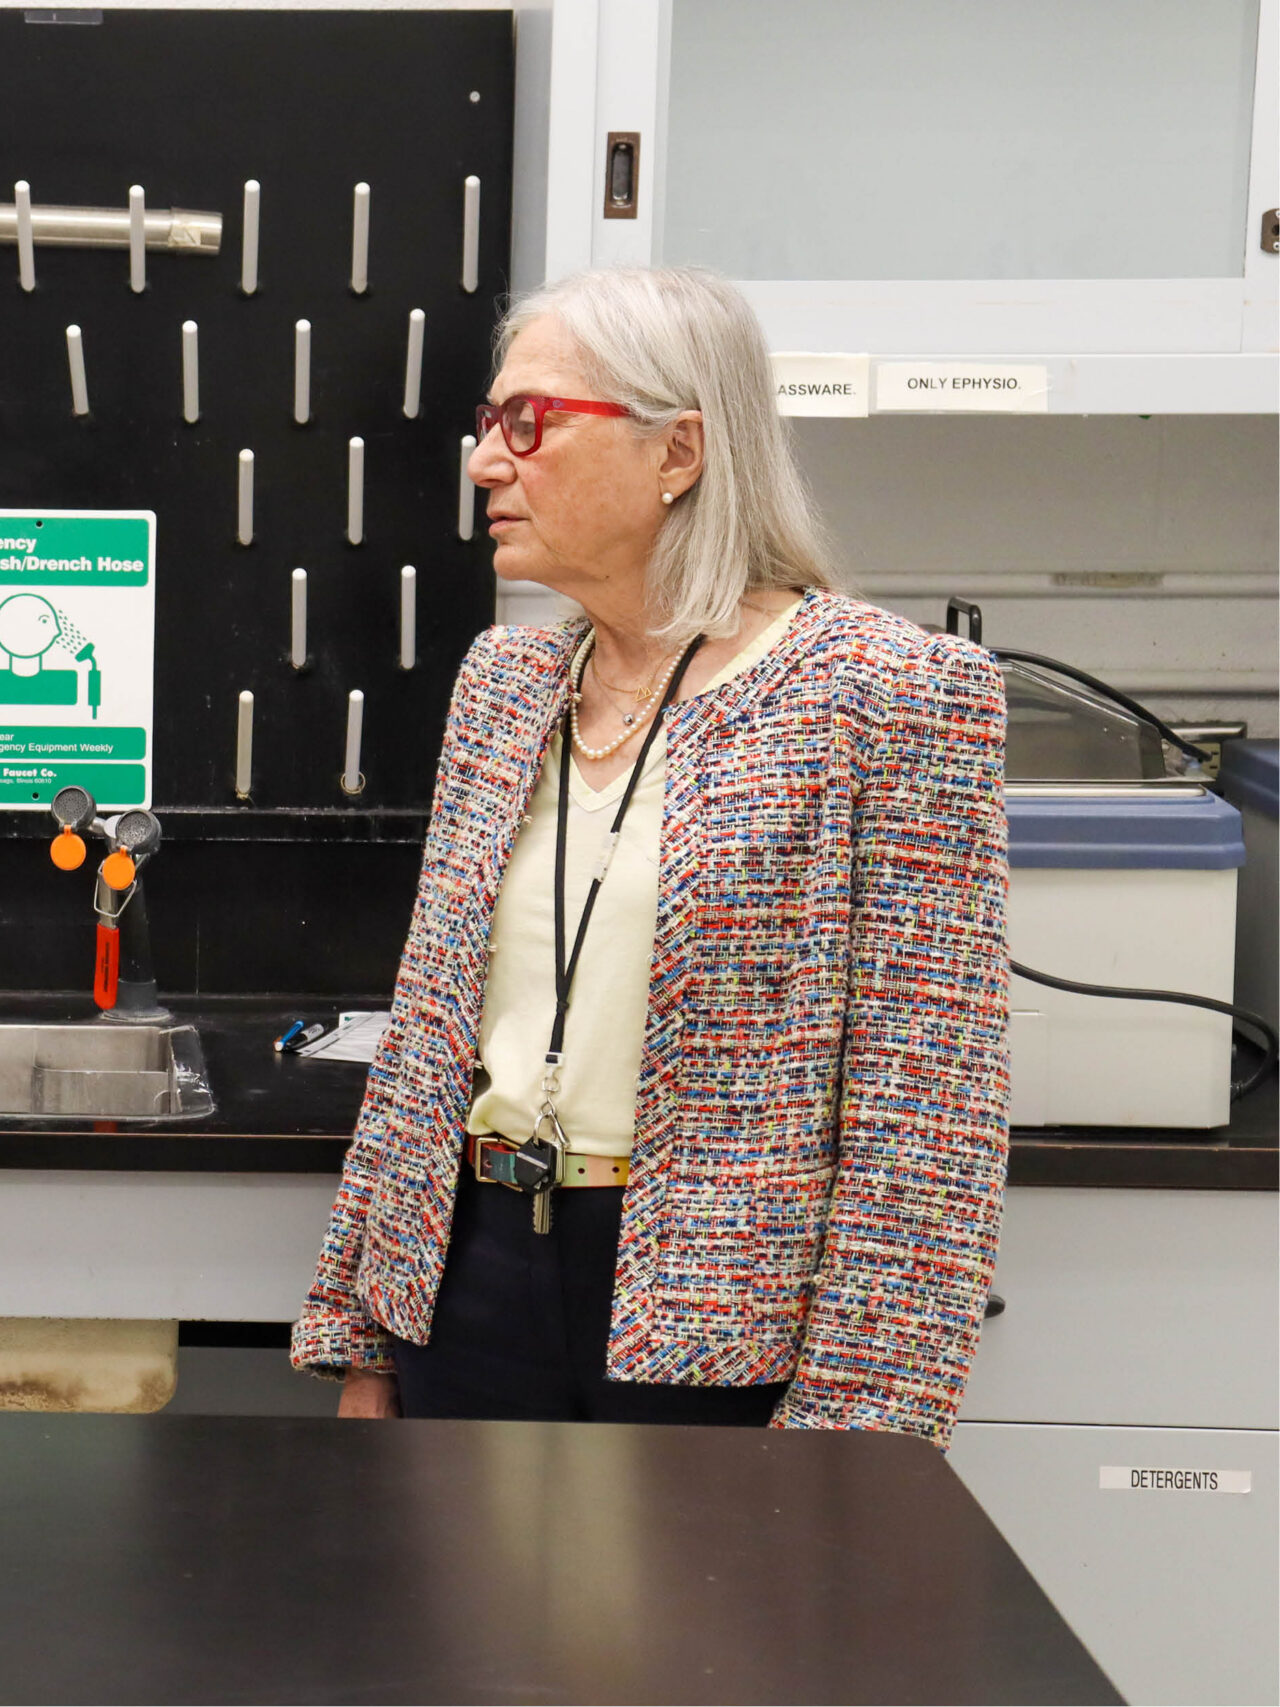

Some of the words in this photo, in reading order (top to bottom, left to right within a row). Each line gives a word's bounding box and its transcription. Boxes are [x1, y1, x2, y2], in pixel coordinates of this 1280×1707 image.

[777, 382, 856, 396] ASSWARE.
[907, 377, 948, 390] ONLY
[951, 377, 1021, 390] EPHYSIO.
[97, 557, 144, 572] Hose
[28, 743, 78, 753] Equipment
[79, 744, 114, 754] Weekly
[3, 768, 38, 777] Faucet
[40, 768, 58, 778] Co.
[1131, 1469, 1219, 1490] DETERGENTS
